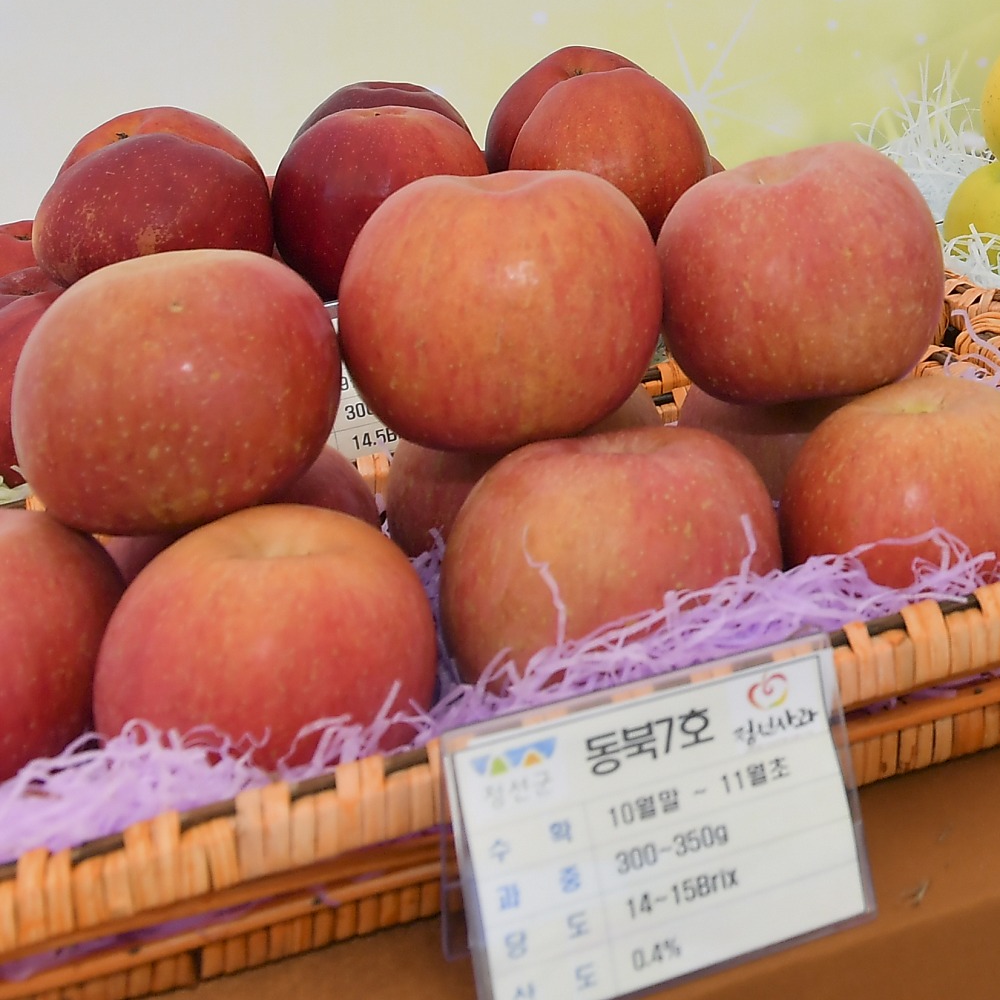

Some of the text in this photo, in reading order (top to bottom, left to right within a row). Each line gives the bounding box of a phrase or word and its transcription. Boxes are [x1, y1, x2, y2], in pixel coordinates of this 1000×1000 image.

[586, 708, 714, 775] 동북7호
[722, 756, 790, 793] 11월초
[632, 937, 681, 972] 0.4%
